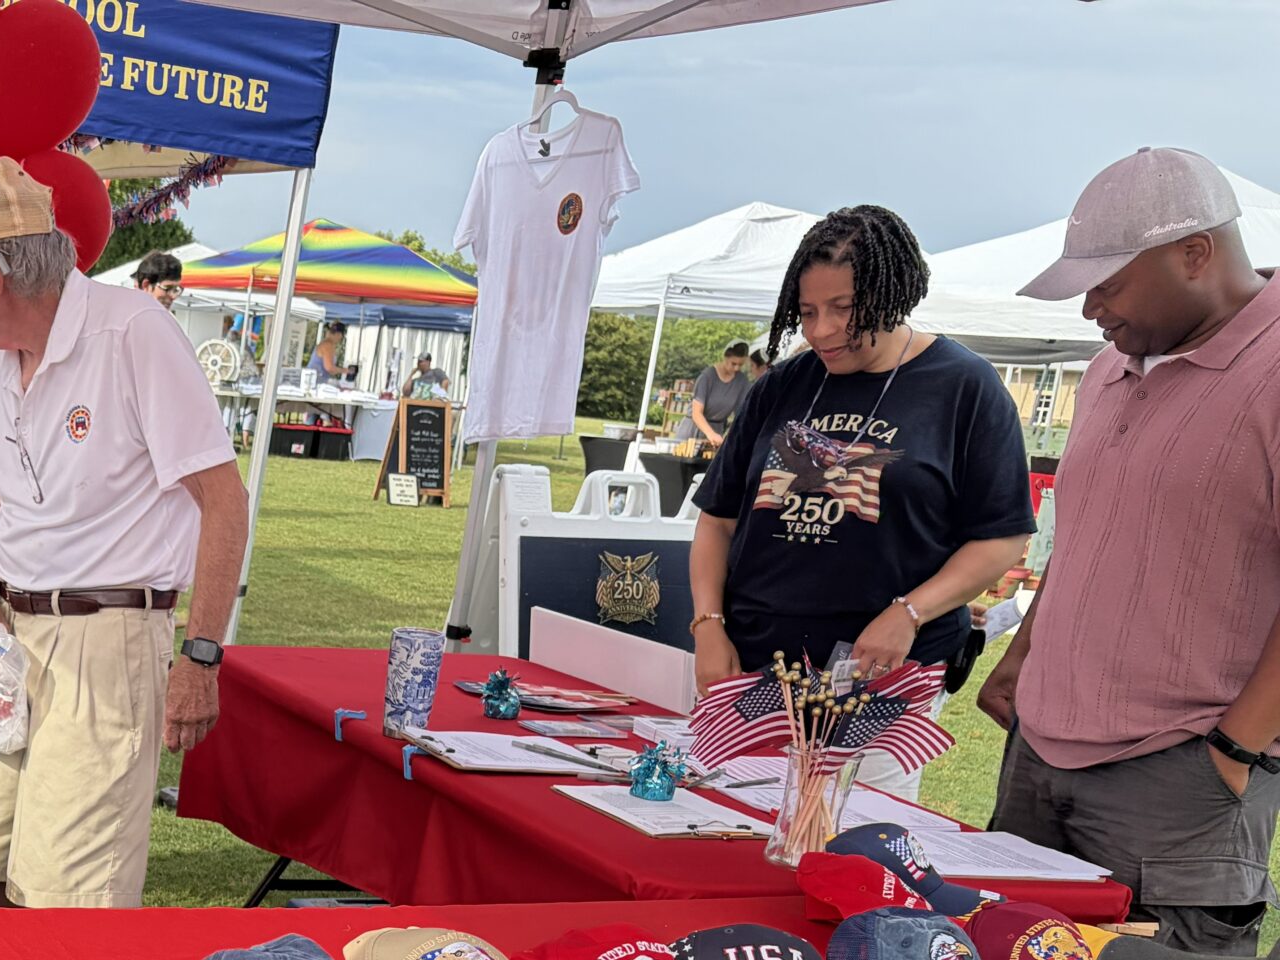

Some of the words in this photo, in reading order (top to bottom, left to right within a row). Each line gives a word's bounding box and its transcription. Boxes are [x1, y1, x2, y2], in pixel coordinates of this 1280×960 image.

[121, 57, 269, 114] FUTURE
[1144, 218, 1199, 238] Australia
[810, 413, 899, 444] MERCA
[780, 494, 845, 525] 250
[786, 521, 831, 536] YEARS
[613, 580, 643, 600] 250
[607, 603, 649, 615] ANNIVERSARY
